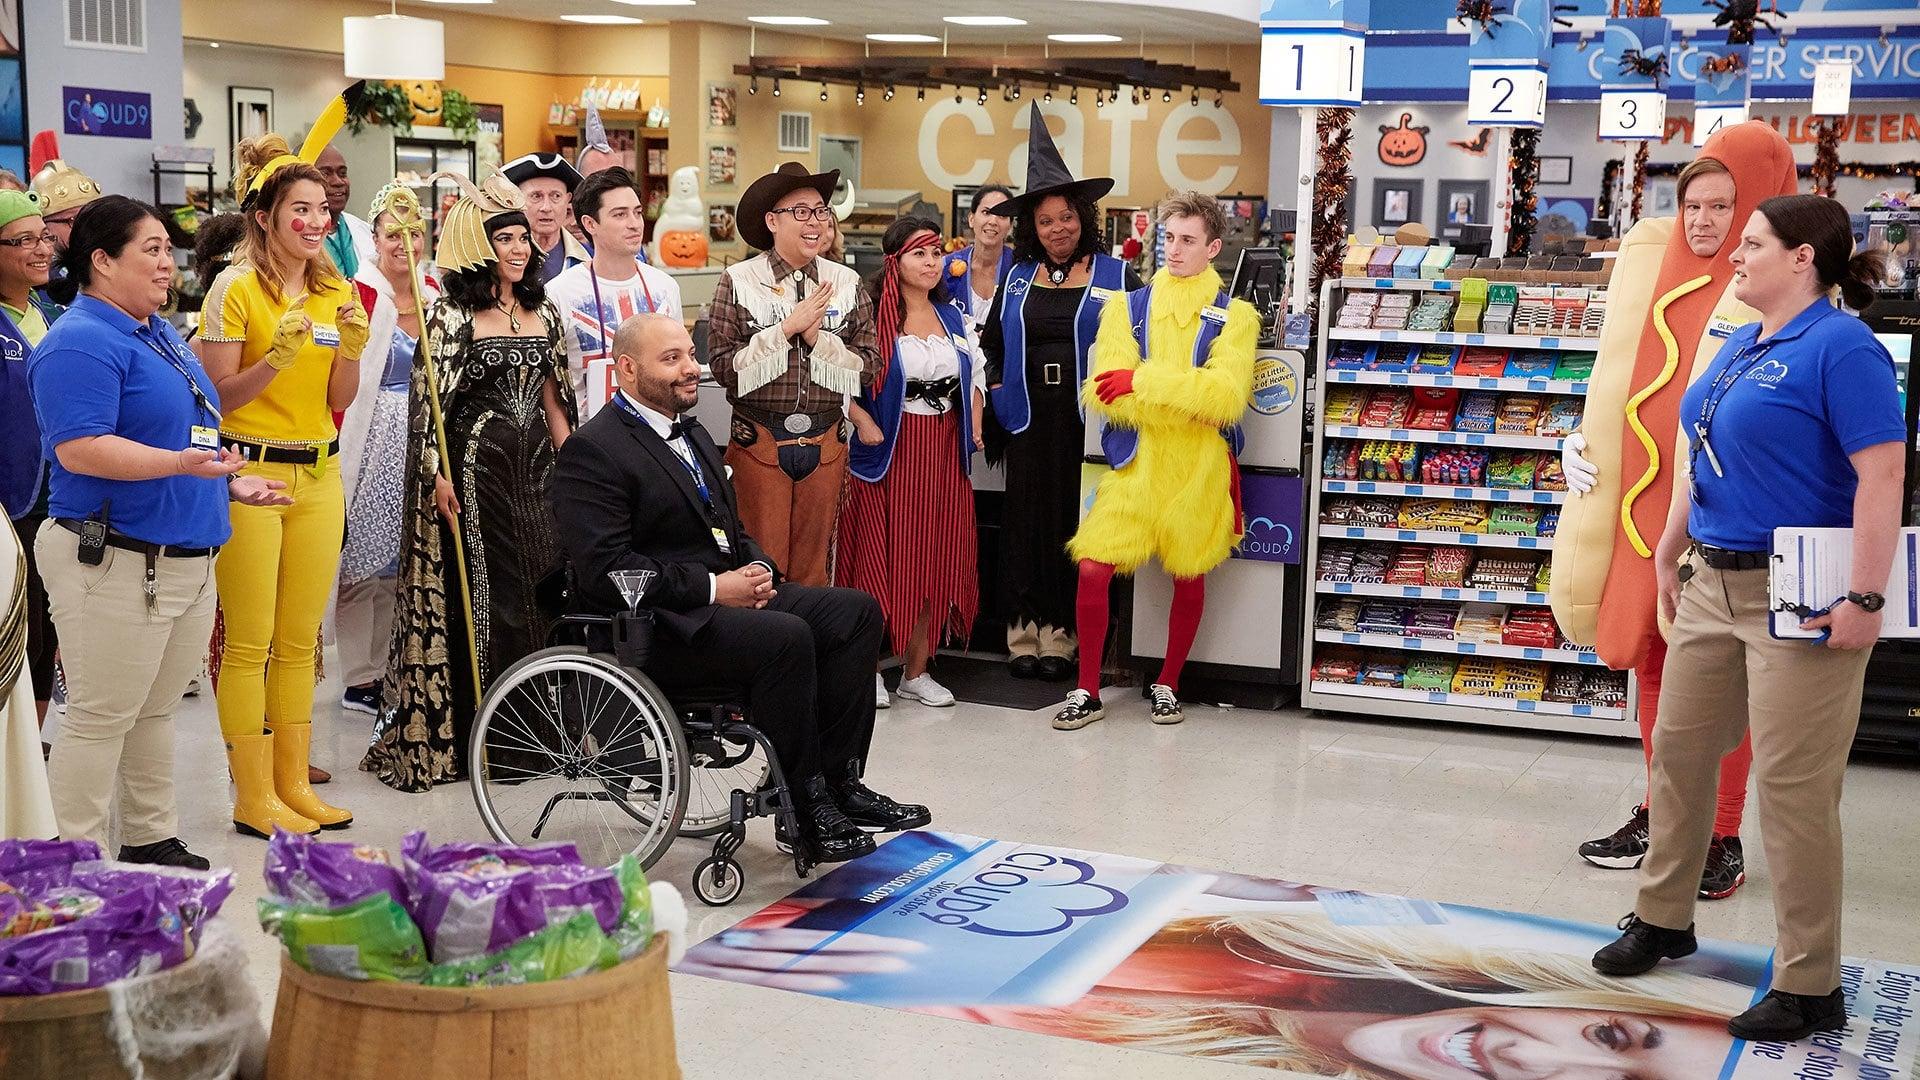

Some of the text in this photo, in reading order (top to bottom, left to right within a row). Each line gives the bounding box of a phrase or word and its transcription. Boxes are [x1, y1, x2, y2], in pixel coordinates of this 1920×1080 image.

[1291, 45, 1303, 90] 1
[1349, 46, 1354, 91] 1
[1490, 78, 1514, 113] 2
[1536, 80, 1543, 115] 2
[67, 99, 149, 128] COUD9
[1619, 99, 1637, 129] 3
[918, 82, 1242, 197] cafe
[1260, 380, 1268, 389] of
[1269, 372, 1296, 386] Heaven
[1268, 365, 1286, 378] Little
[1243, 541, 1290, 555] LOUD9
[892, 880, 958, 918] superstore
[918, 852, 1058, 926] CLOUD9
[1874, 970, 1920, 1005] Enjoy
[1873, 1004, 1913, 1028] the
[1863, 1027, 1901, 1064] same
